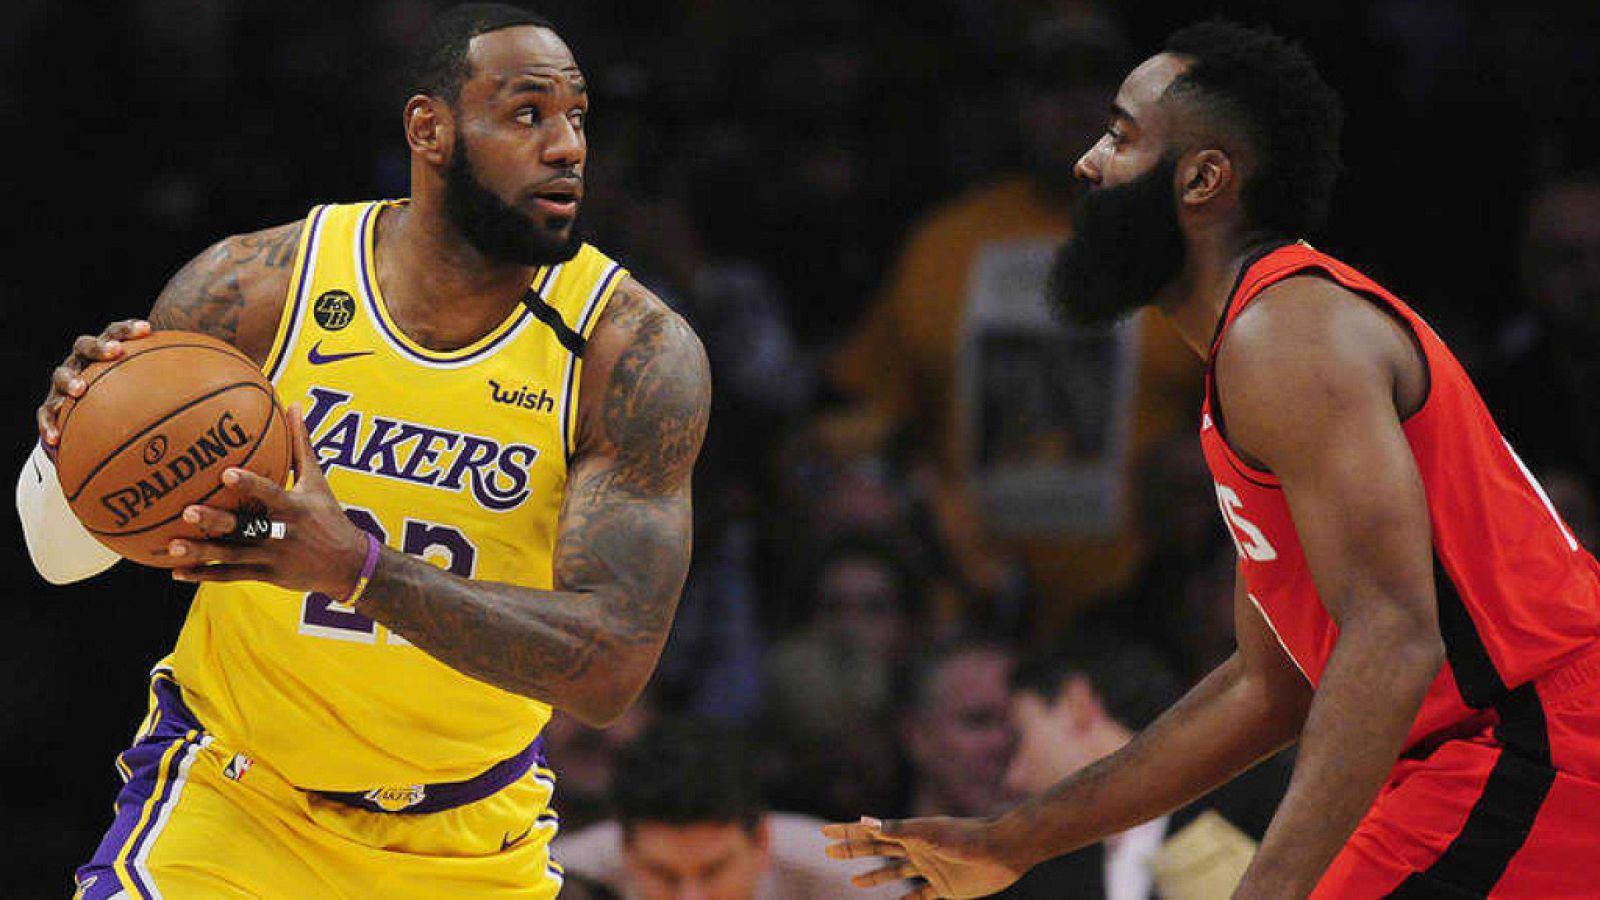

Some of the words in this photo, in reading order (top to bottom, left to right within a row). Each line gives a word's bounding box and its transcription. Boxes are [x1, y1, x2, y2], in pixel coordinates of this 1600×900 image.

[303, 386, 541, 512] LAKERS
[488, 379, 555, 413] wish
[102, 411, 253, 527] SPALDING
